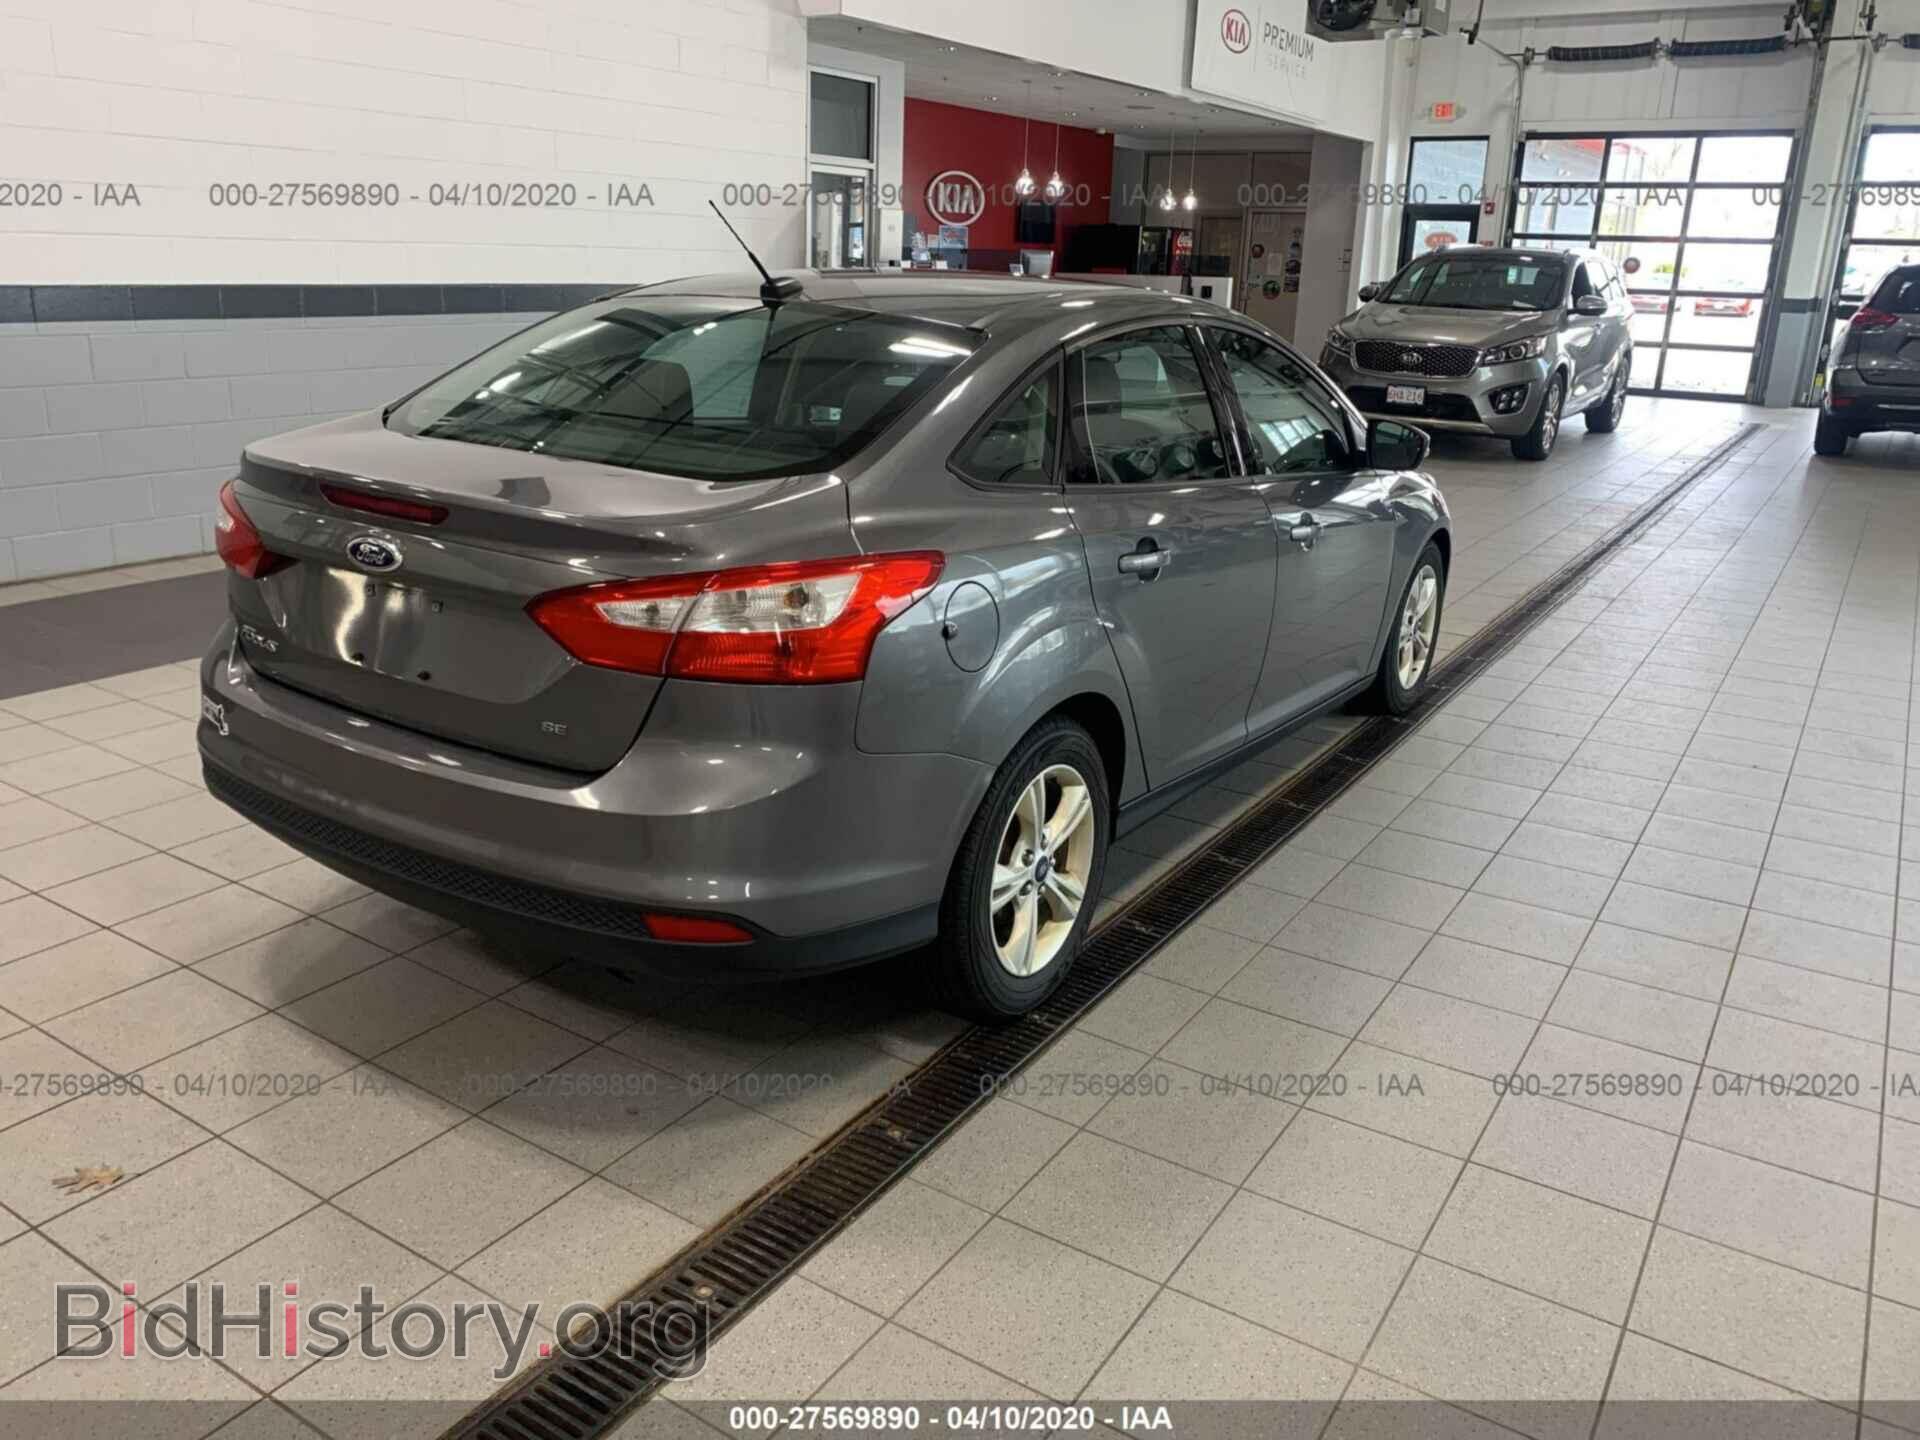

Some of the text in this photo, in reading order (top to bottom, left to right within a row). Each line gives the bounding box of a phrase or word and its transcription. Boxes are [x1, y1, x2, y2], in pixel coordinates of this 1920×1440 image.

[1263, 21, 1314, 62] PREMIUM
[938, 181, 976, 215] KIA
[541, 721, 567, 736] SE
